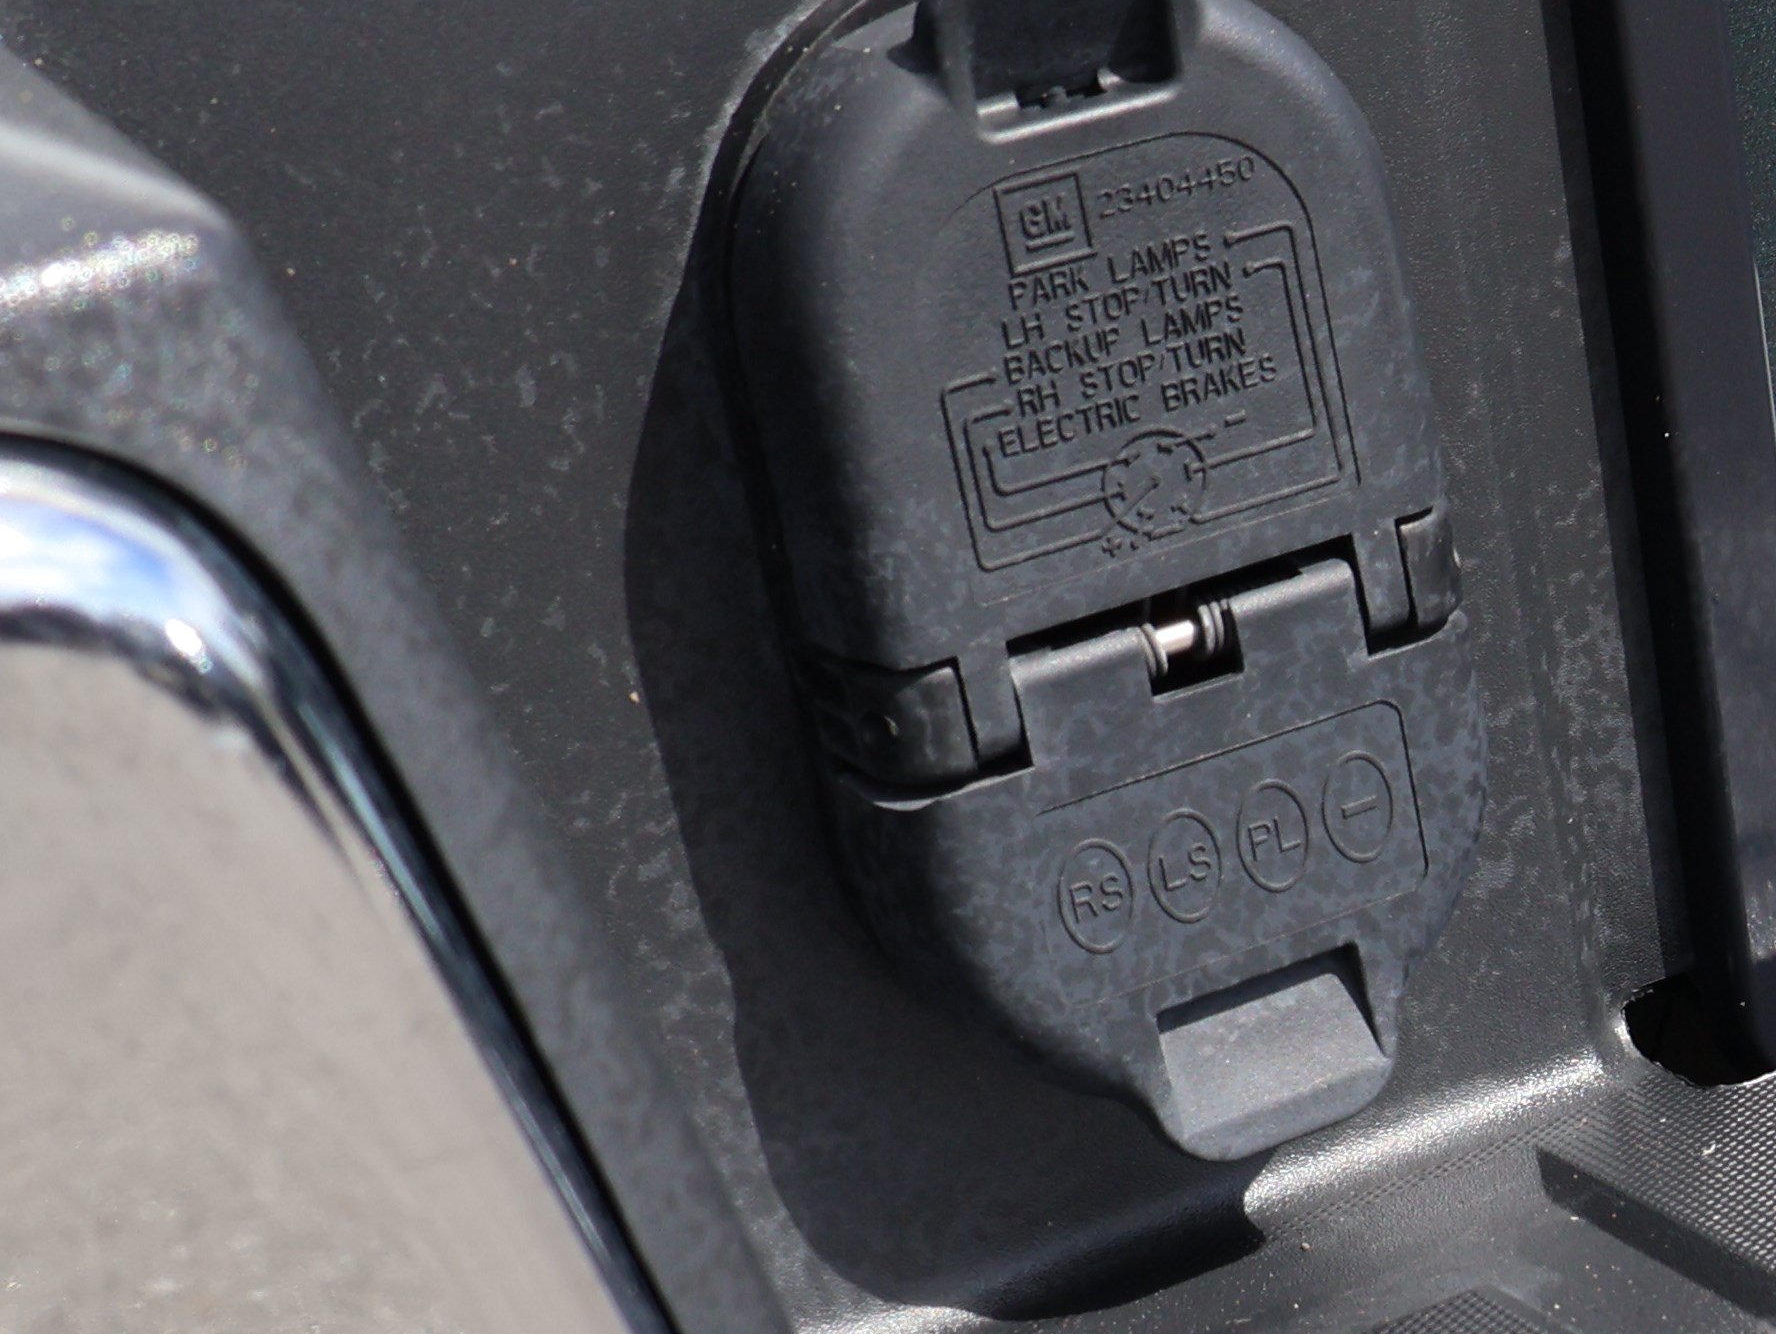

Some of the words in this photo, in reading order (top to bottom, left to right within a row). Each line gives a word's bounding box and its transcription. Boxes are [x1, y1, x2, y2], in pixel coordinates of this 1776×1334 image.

[1018, 193, 1073, 240] GM
[1096, 155, 1257, 219] 23404450
[1001, 313, 1045, 351] LH
[1065, 265, 1233, 333] STOP/TURN
[1007, 268, 1090, 311] PARK
[1107, 231, 1212, 284] LAMPS
[1003, 327, 1121, 386] BACKUP
[1141, 294, 1245, 346] LAMPS
[1017, 384, 1061, 419] RH
[1080, 327, 1247, 399] STOP/TURN
[998, 393, 1141, 459] ELECTRIC
[1160, 354, 1279, 413] BRAKES
[1068, 873, 1124, 923] RS
[1158, 842, 1213, 893] LS
[1247, 816, 1301, 863] PL
